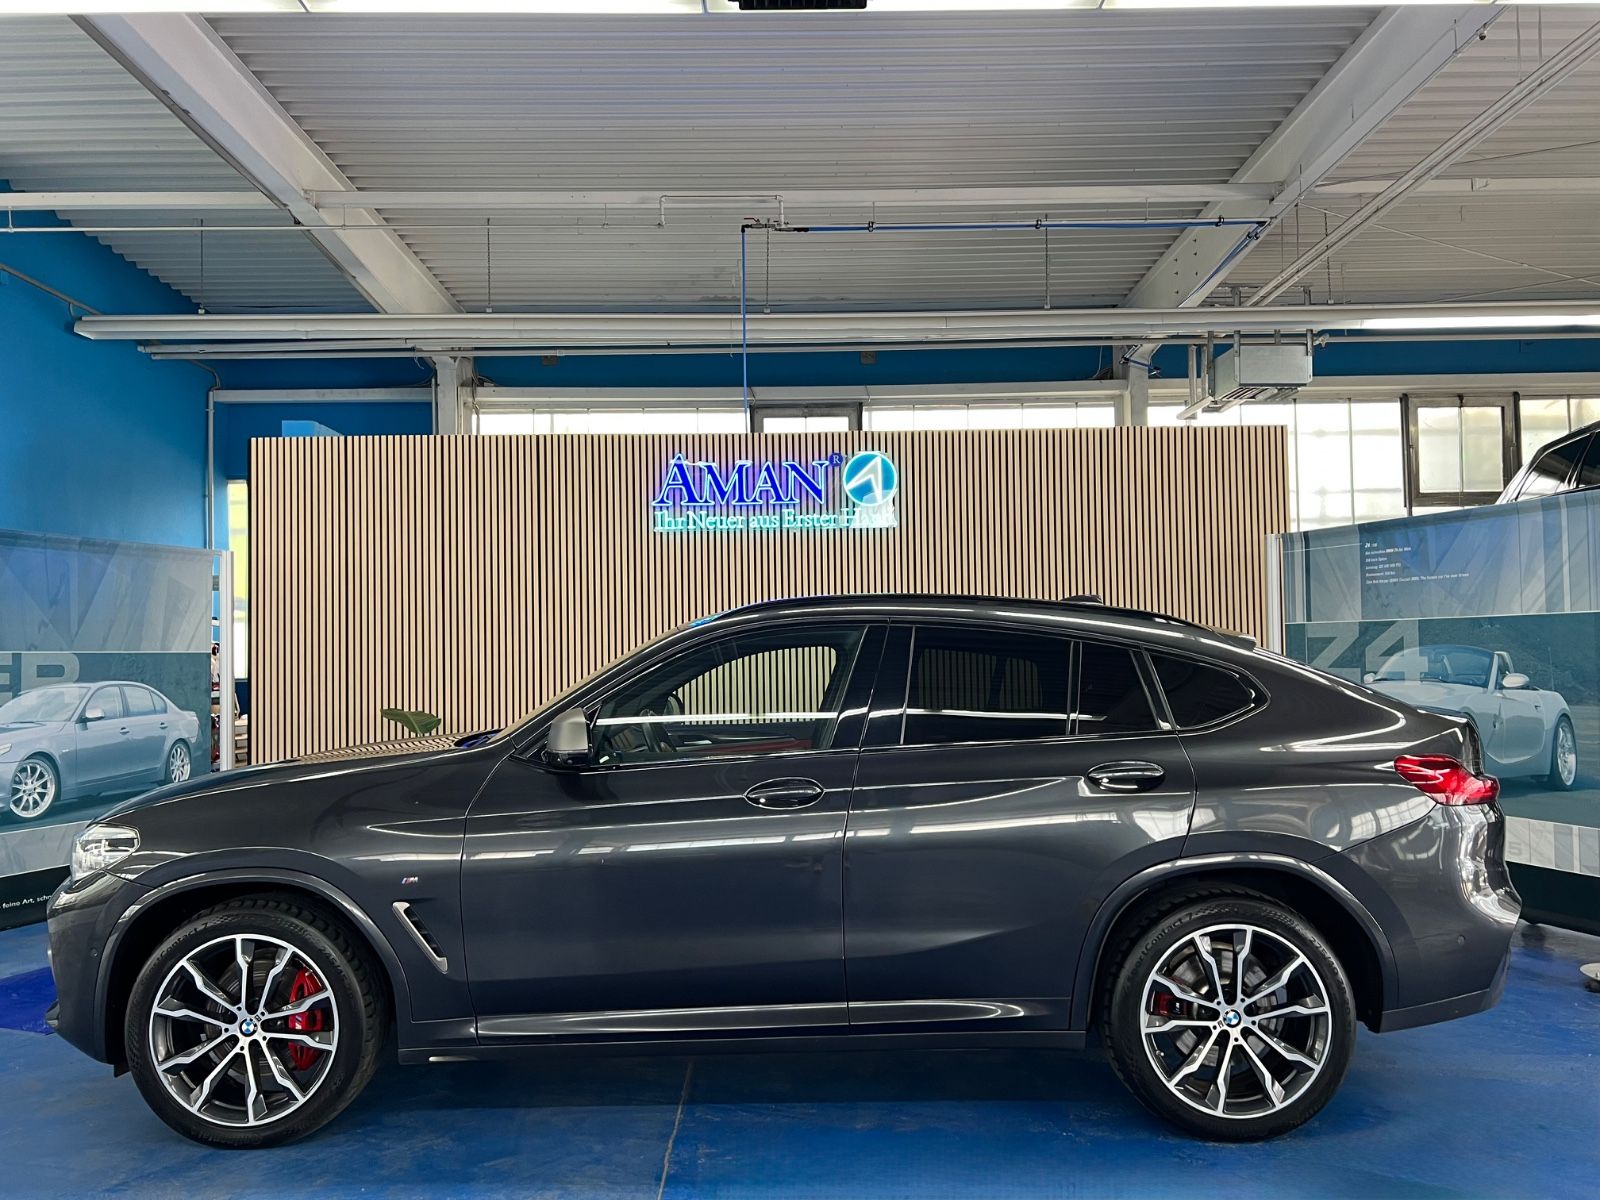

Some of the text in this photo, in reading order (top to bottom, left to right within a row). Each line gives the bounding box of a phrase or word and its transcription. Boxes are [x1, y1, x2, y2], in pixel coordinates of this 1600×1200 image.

[651, 453, 829, 506] AMAN
[654, 510, 686, 529] Ihr
[686, 510, 745, 529] Neuer
[749, 515, 780, 528] aus
[782, 508, 838, 528] Erster
[1305, 619, 1428, 684] Z4
